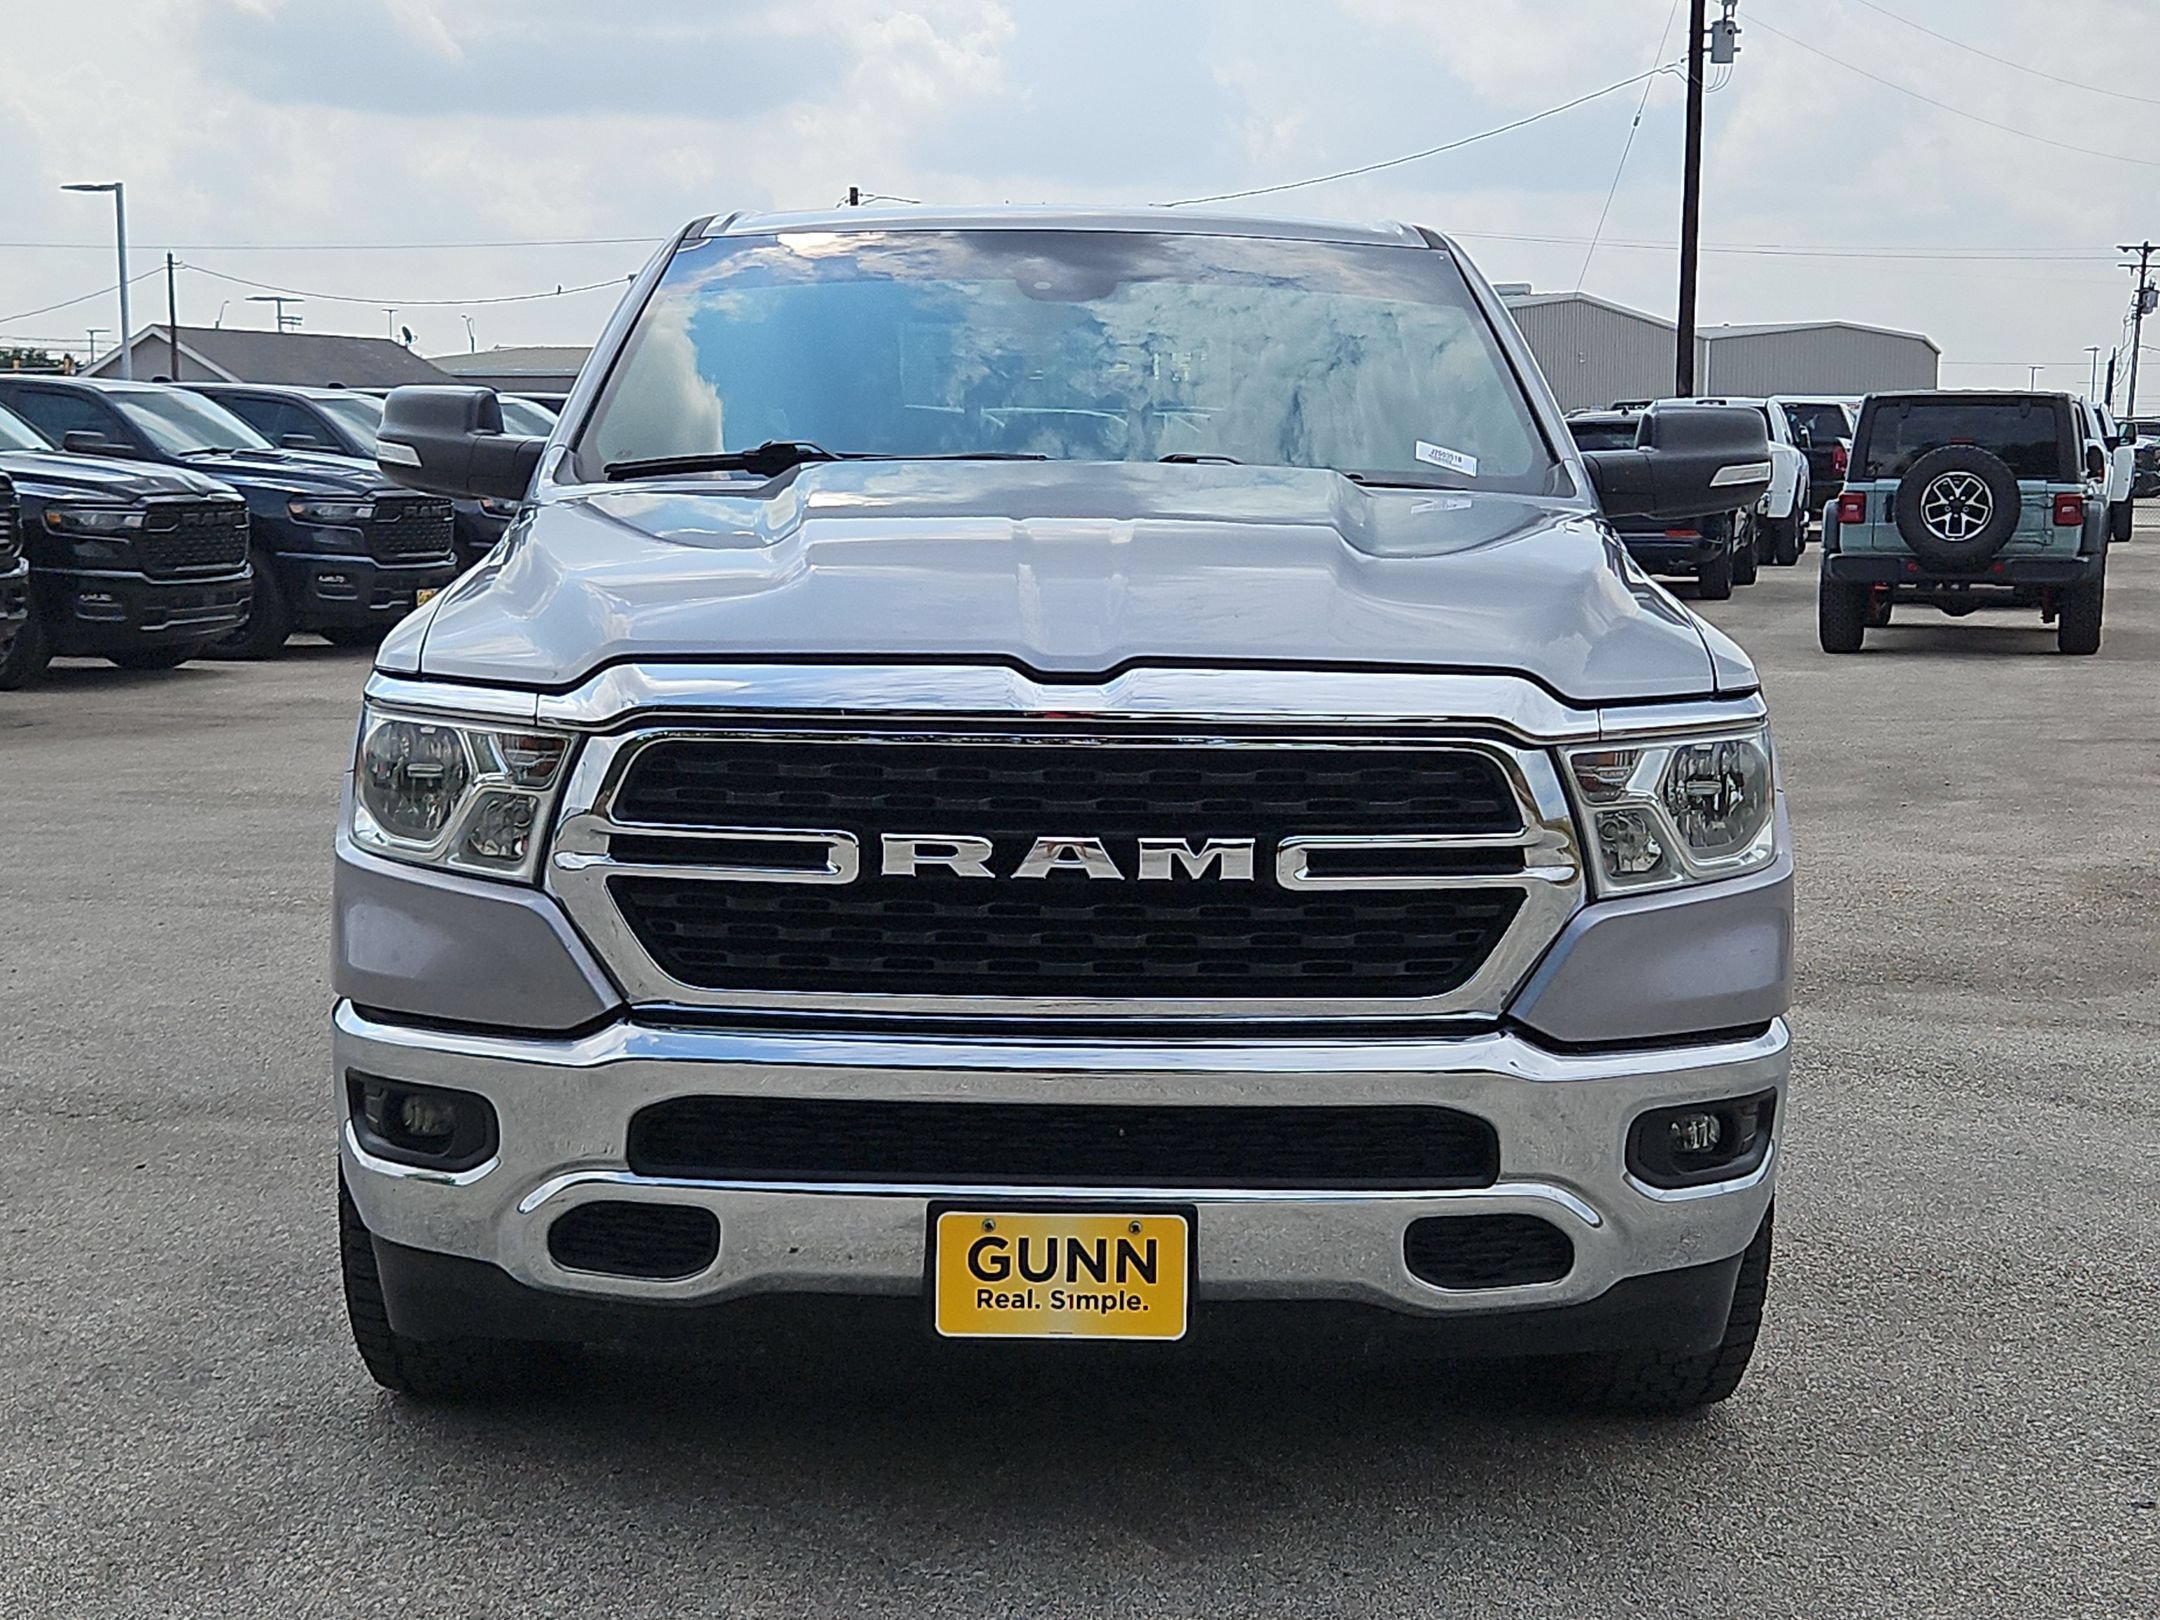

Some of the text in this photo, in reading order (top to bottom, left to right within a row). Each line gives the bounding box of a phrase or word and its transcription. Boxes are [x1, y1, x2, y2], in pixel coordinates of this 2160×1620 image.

[880, 833, 1256, 881] RAM
[967, 1235, 1158, 1285] GUNN
[975, 1288, 1041, 1310] Real.
